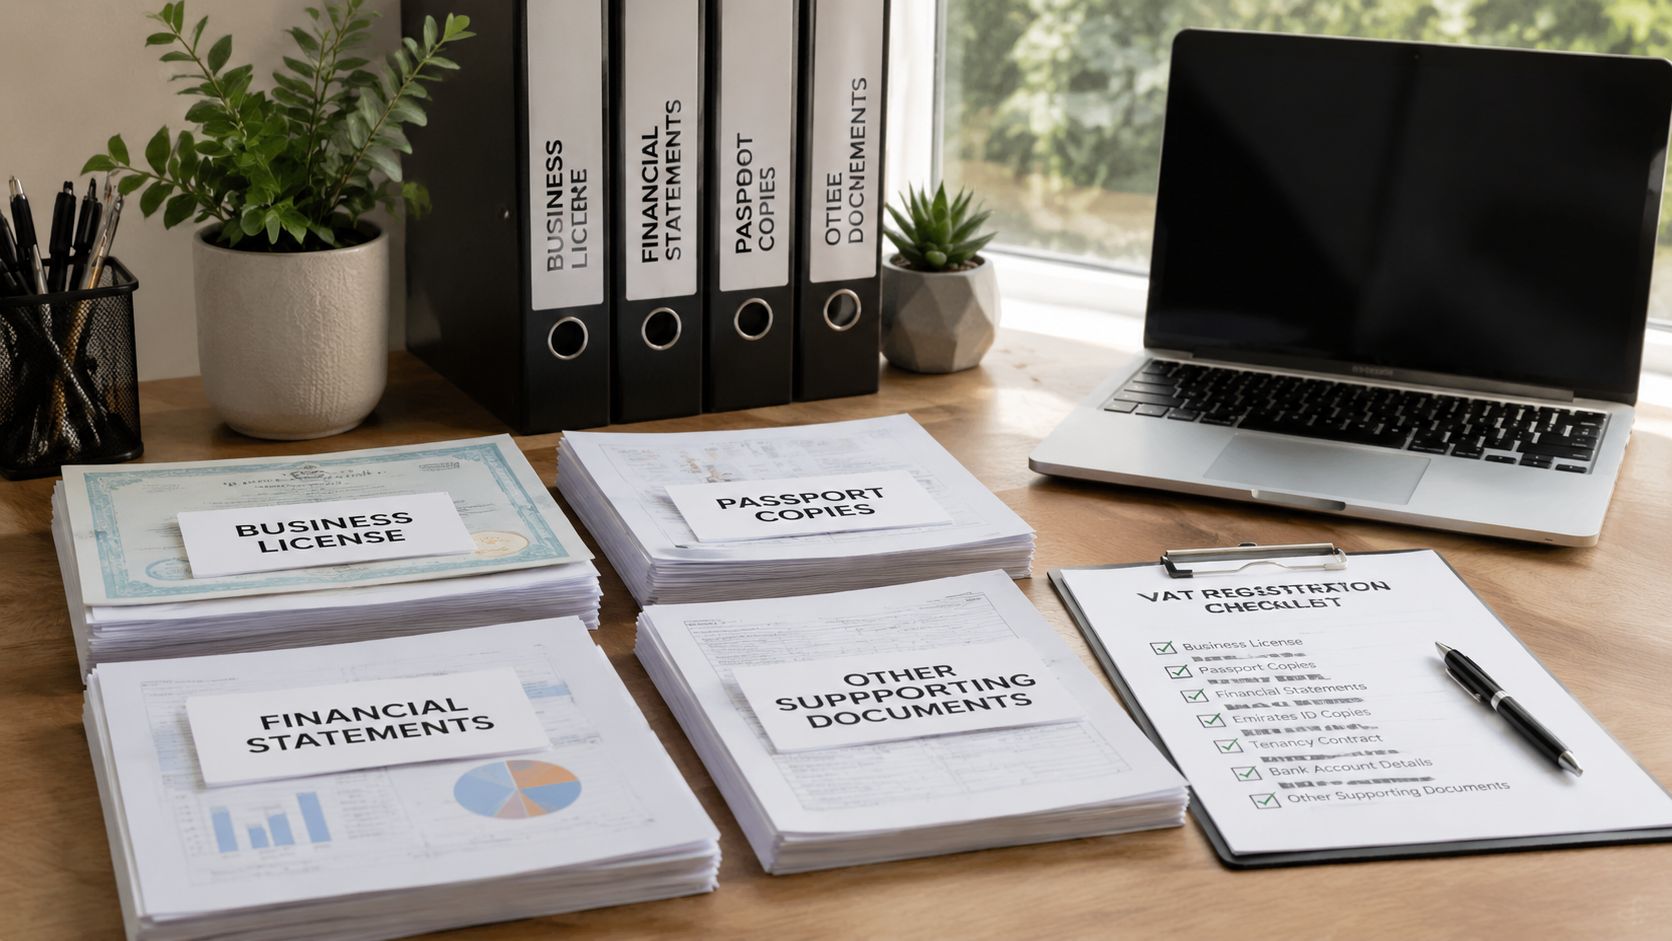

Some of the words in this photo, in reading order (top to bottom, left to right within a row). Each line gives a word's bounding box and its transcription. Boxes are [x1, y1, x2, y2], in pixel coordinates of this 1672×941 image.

[665, 99, 682, 261] STATEMENTS
[545, 139, 564, 272] BUSINESS
[641, 125, 659, 264] FINANCIAL
[758, 166, 776, 252] COPIES
[715, 487, 884, 510] PASSPORT
[235, 511, 413, 538] BUSINESS
[754, 503, 876, 523] COPIES
[257, 529, 406, 554] LICENSE
[1137, 589, 1194, 603] VAT
[1182, 641, 1247, 652] Business
[1248, 639, 1304, 648] License
[843, 664, 957, 687] OTHER
[1198, 663, 1265, 675] Passport
[1266, 661, 1317, 672] Copies
[775, 673, 1036, 712] SUPPPORTING
[1215, 686, 1281, 699] Financial
[1282, 683, 1368, 695] Statements
[260, 697, 469, 731] FINANCIAL
[806, 692, 1033, 729] DOCUMENTS
[1231, 713, 1298, 724] Emirates
[1299, 711, 1318, 720] ID
[1320, 709, 1372, 719] Copies
[246, 715, 495, 754] STATEMENTS
[1248, 738, 1314, 750] Tenancy
[1317, 734, 1384, 745] Contract
[1268, 765, 1310, 777] Bank
[1314, 761, 1378, 774] Account
[1378, 757, 1433, 769] Details
[1287, 792, 1331, 803] Other
[1334, 787, 1422, 801] Supporting
[1422, 782, 1511, 795] Documents
